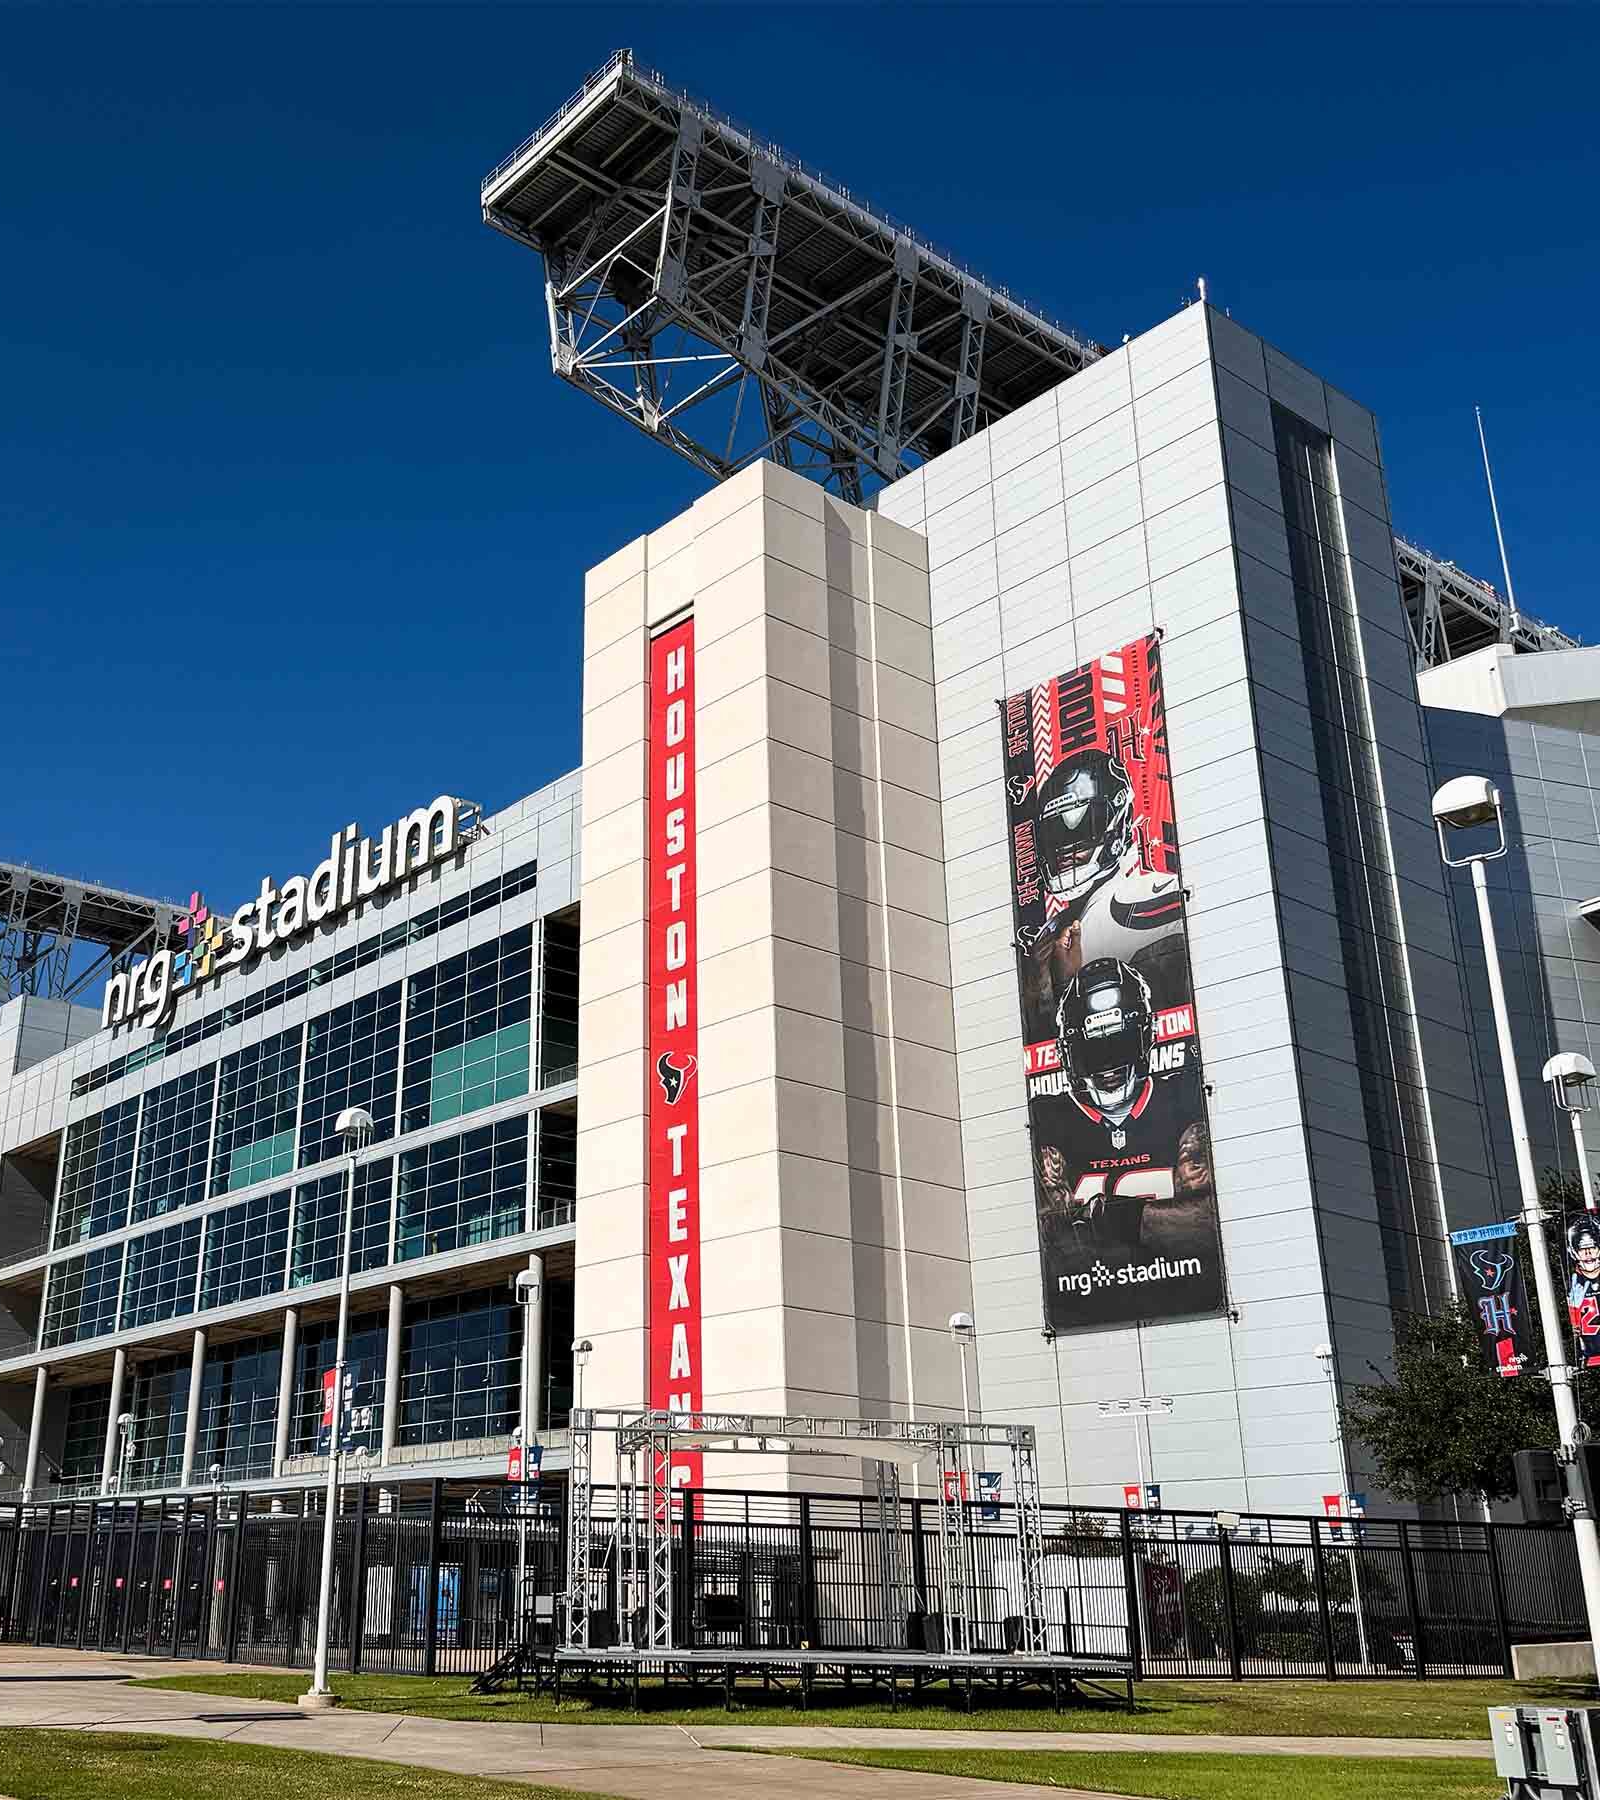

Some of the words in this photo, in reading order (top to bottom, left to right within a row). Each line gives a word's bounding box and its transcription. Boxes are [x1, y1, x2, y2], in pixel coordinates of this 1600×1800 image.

[665, 645, 687, 1033] HOUSTON
[102, 948, 175, 1029] nrg
[221, 795, 458, 966] stadium
[1149, 1042, 1186, 1074] ANS
[1090, 1153, 1151, 1169] TEXANS
[1058, 1273, 1092, 1296] nrg
[1117, 1257, 1201, 1285] stadium
